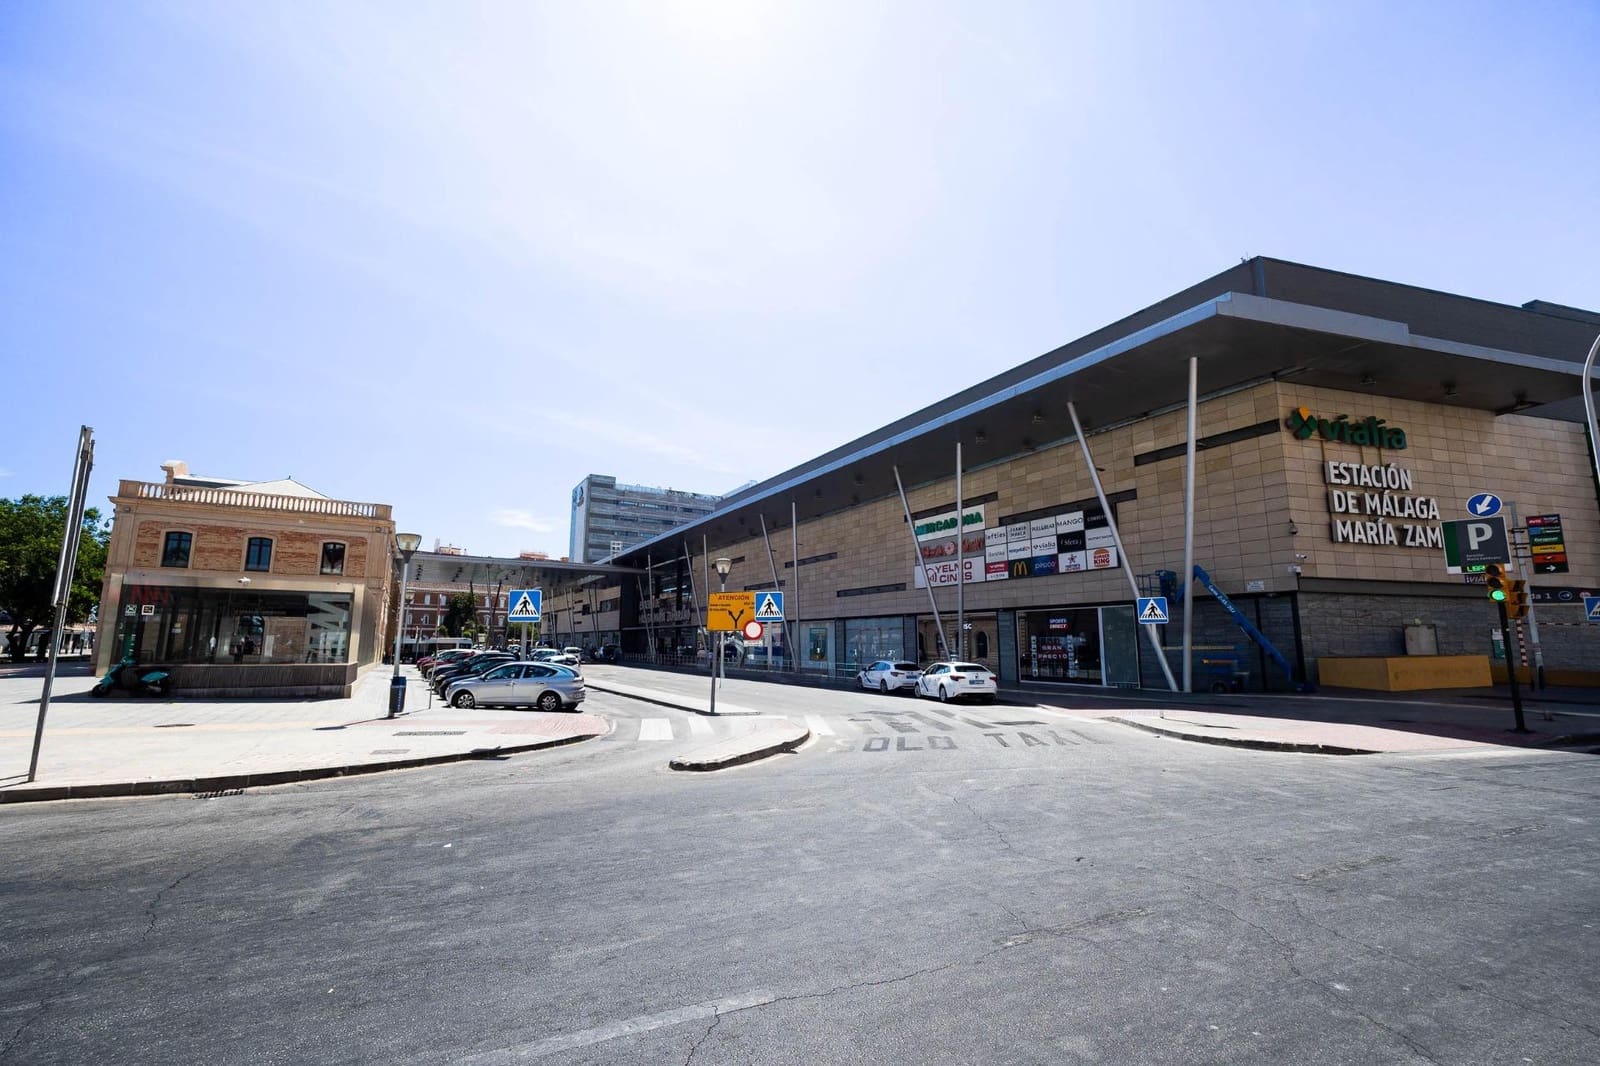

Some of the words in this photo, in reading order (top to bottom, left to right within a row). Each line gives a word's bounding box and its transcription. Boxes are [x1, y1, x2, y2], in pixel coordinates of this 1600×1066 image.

[1326, 461, 1412, 490] ESTACIÓN
[1331, 490, 1361, 514] DE
[1364, 490, 1440, 519] MÁLAGA
[1056, 517, 1083, 526] MANGO
[1334, 518, 1398, 546] MARÍA
[1403, 524, 1443, 548] ZAM
[1467, 523, 1493, 550] P
[1035, 561, 1056, 569] pepco
[939, 572, 972, 583] CINS
[858, 735, 959, 752] OLO
